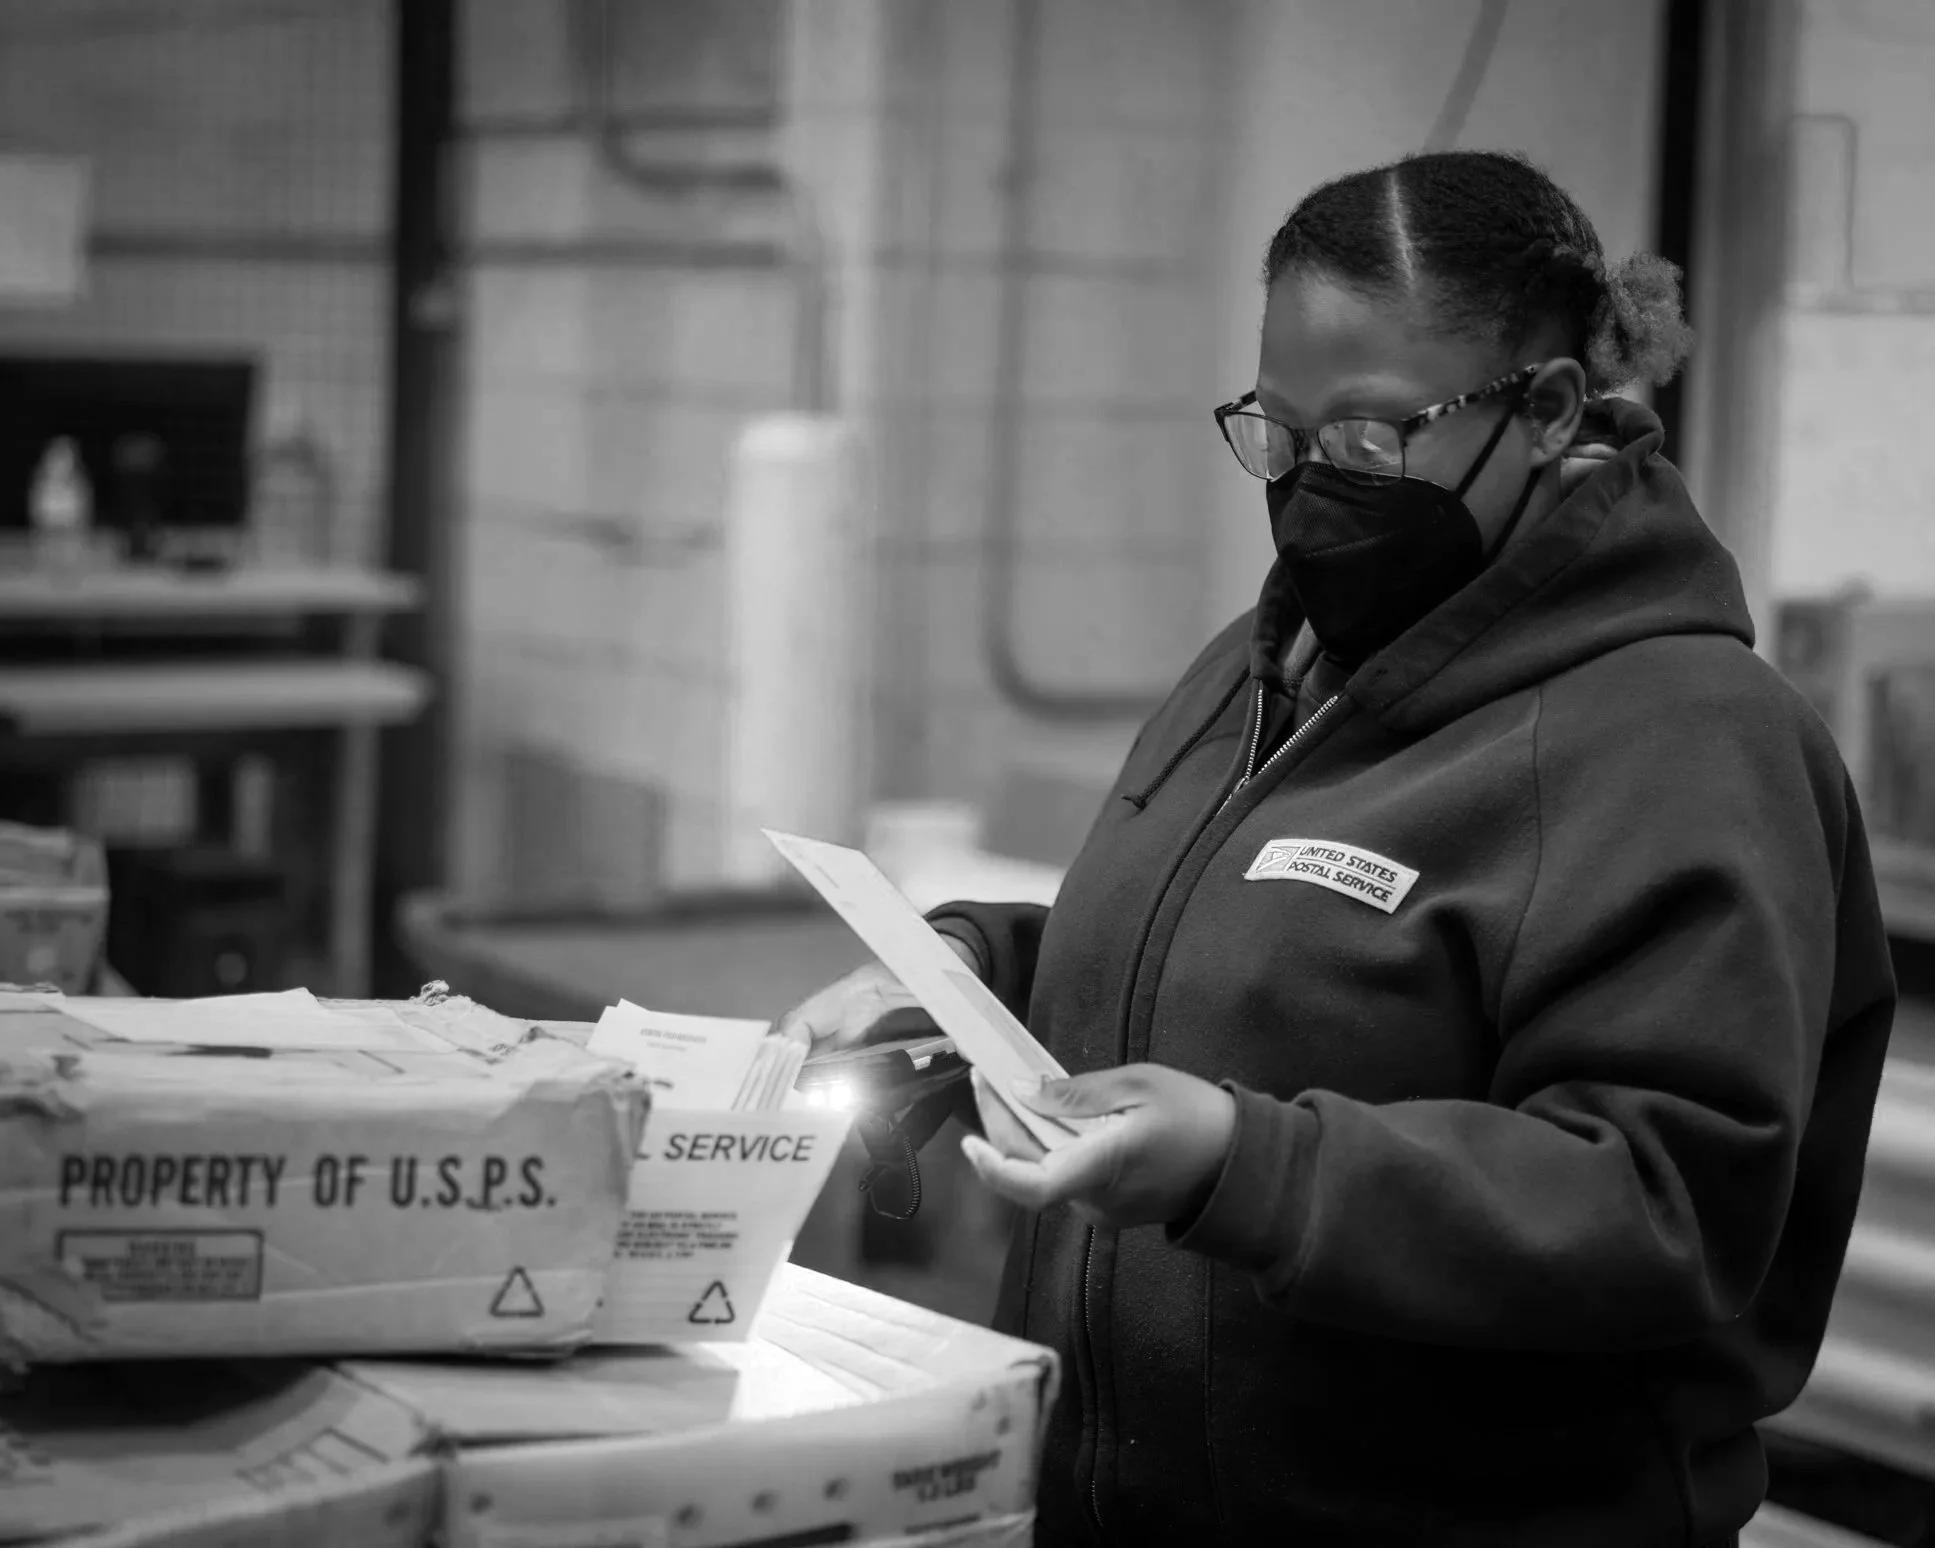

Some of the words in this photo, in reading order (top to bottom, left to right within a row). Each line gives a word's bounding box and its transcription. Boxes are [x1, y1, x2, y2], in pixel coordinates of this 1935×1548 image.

[1286, 861, 1331, 879] POSTAL
[1332, 870, 1393, 904] SERVICE
[1299, 845, 1345, 863] UNITED
[1346, 855, 1398, 884] STATES
[664, 1132, 817, 1162] SERVICE
[59, 1154, 287, 1208] PROPERTY
[313, 1154, 370, 1209] OF
[391, 1154, 557, 1209] U.S.P.S.
